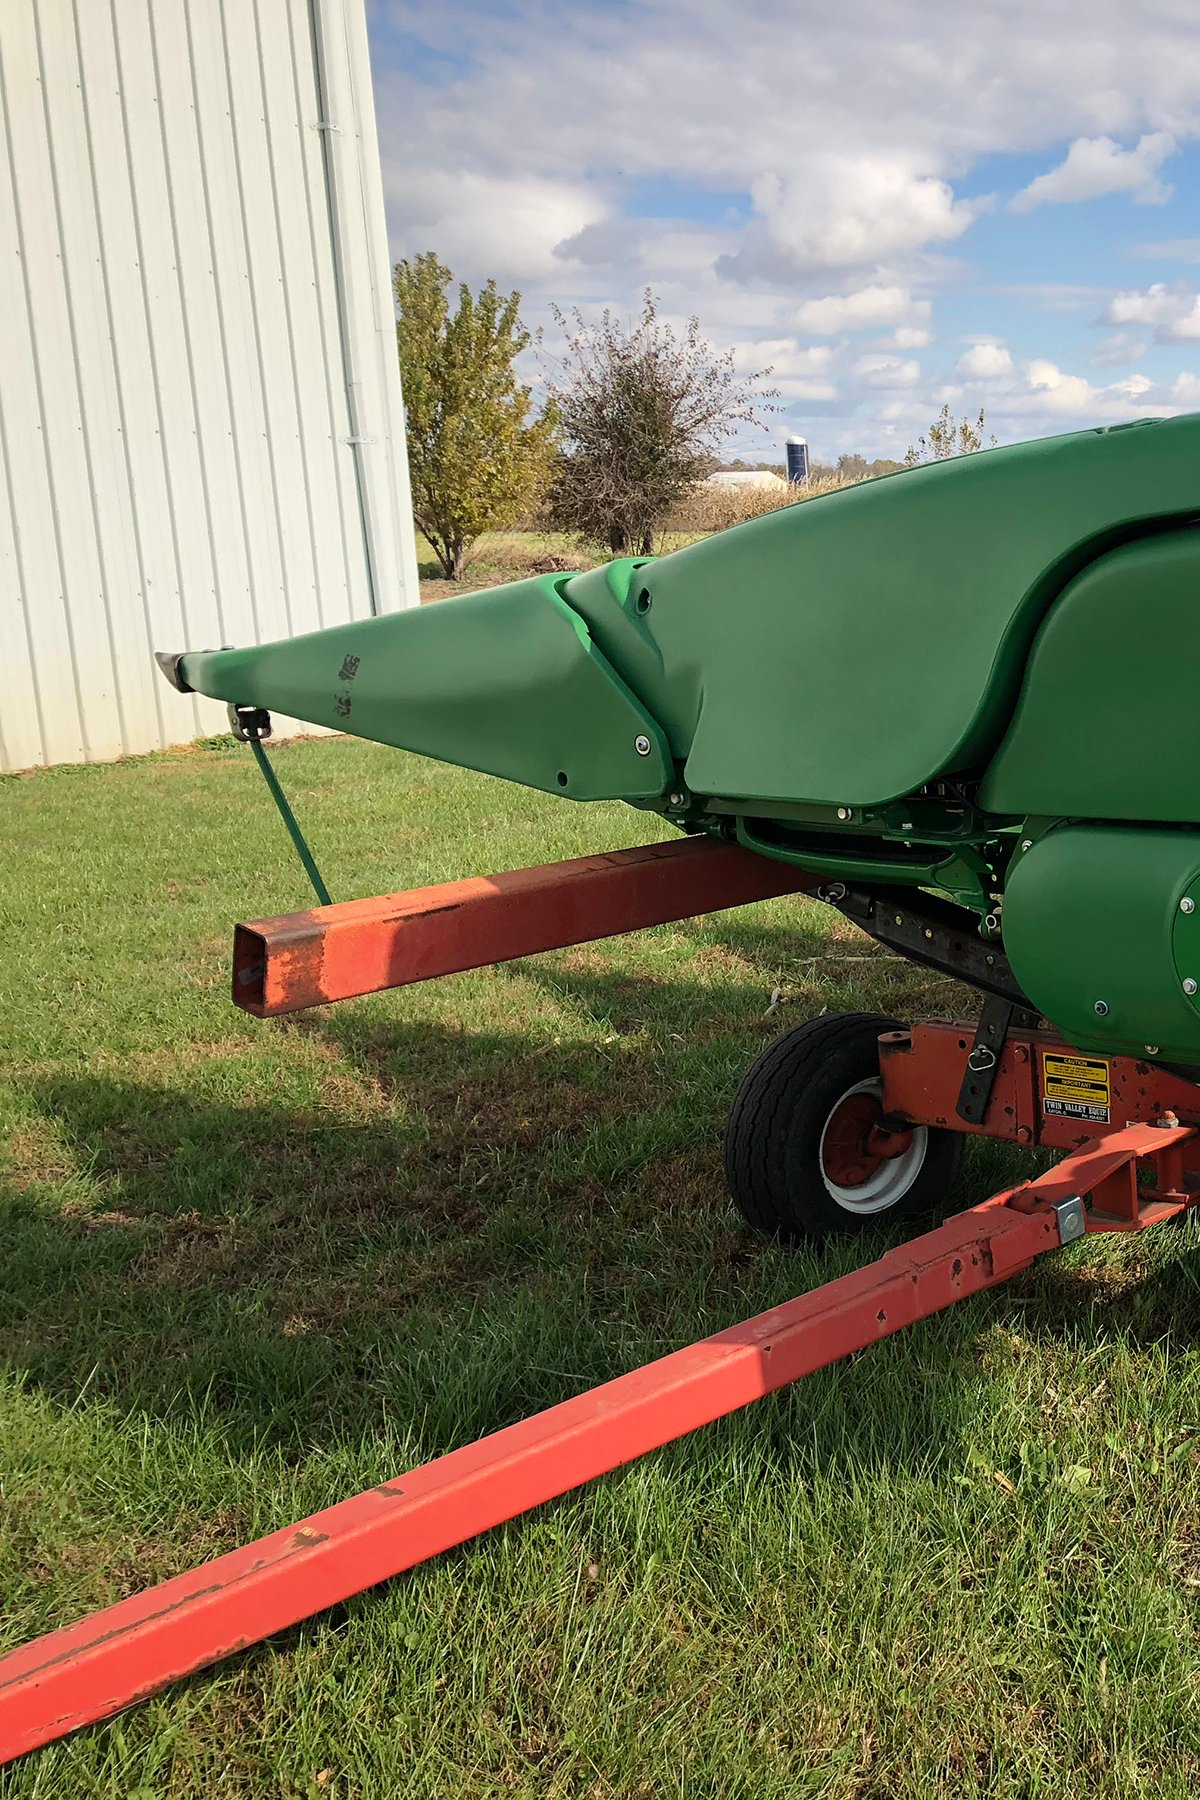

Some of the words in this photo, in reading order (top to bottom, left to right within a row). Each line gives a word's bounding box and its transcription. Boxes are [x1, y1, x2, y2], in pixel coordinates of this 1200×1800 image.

[1064, 1058, 1088, 1066] CAUTION
[1061, 1079, 1091, 1088] IMPORTANT
[1046, 1100, 1062, 1110] TWIN
[1064, 1103, 1087, 1114] VALLEY
